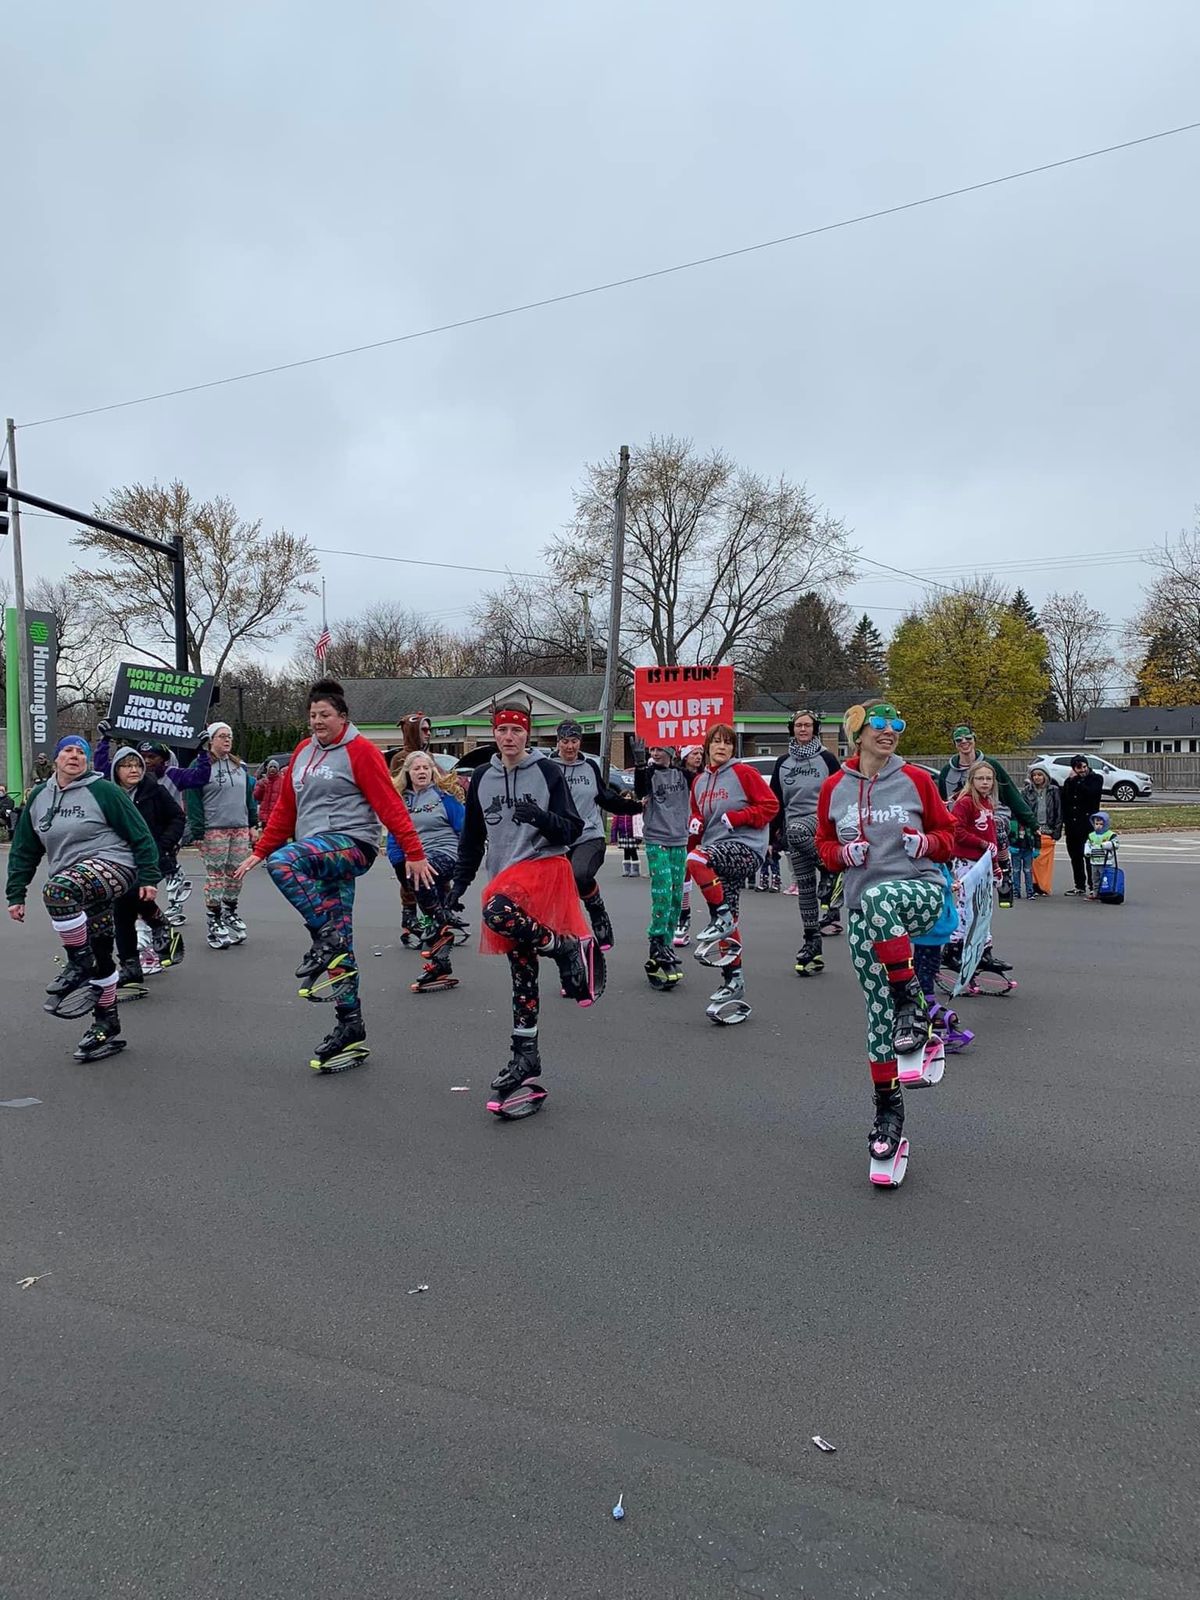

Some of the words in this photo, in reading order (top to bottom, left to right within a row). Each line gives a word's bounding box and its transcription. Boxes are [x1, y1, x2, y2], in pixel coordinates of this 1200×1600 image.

[126, 668, 156, 681] HOW
[156, 672, 174, 683] DO
[174, 675, 179, 684] I
[181, 676, 204, 688] GET
[647, 668, 662, 683] IS
[664, 668, 680, 683] IT
[682, 666, 719, 682] FUN?
[30, 645, 49, 743] Huntington
[129, 679, 161, 693] MORE
[162, 683, 196, 698] INFO?
[127, 694, 155, 708] FIND
[157, 699, 172, 711] US
[173, 702, 190, 713] ON
[641, 699, 683, 718] YOU
[687, 697, 723, 717] BET
[123, 705, 188, 724] FACEBOOK-
[115, 716, 151, 732] JUMPS
[151, 721, 195, 739] FITNESS
[658, 720, 678, 738] IT
[682, 718, 707, 737] IS!
